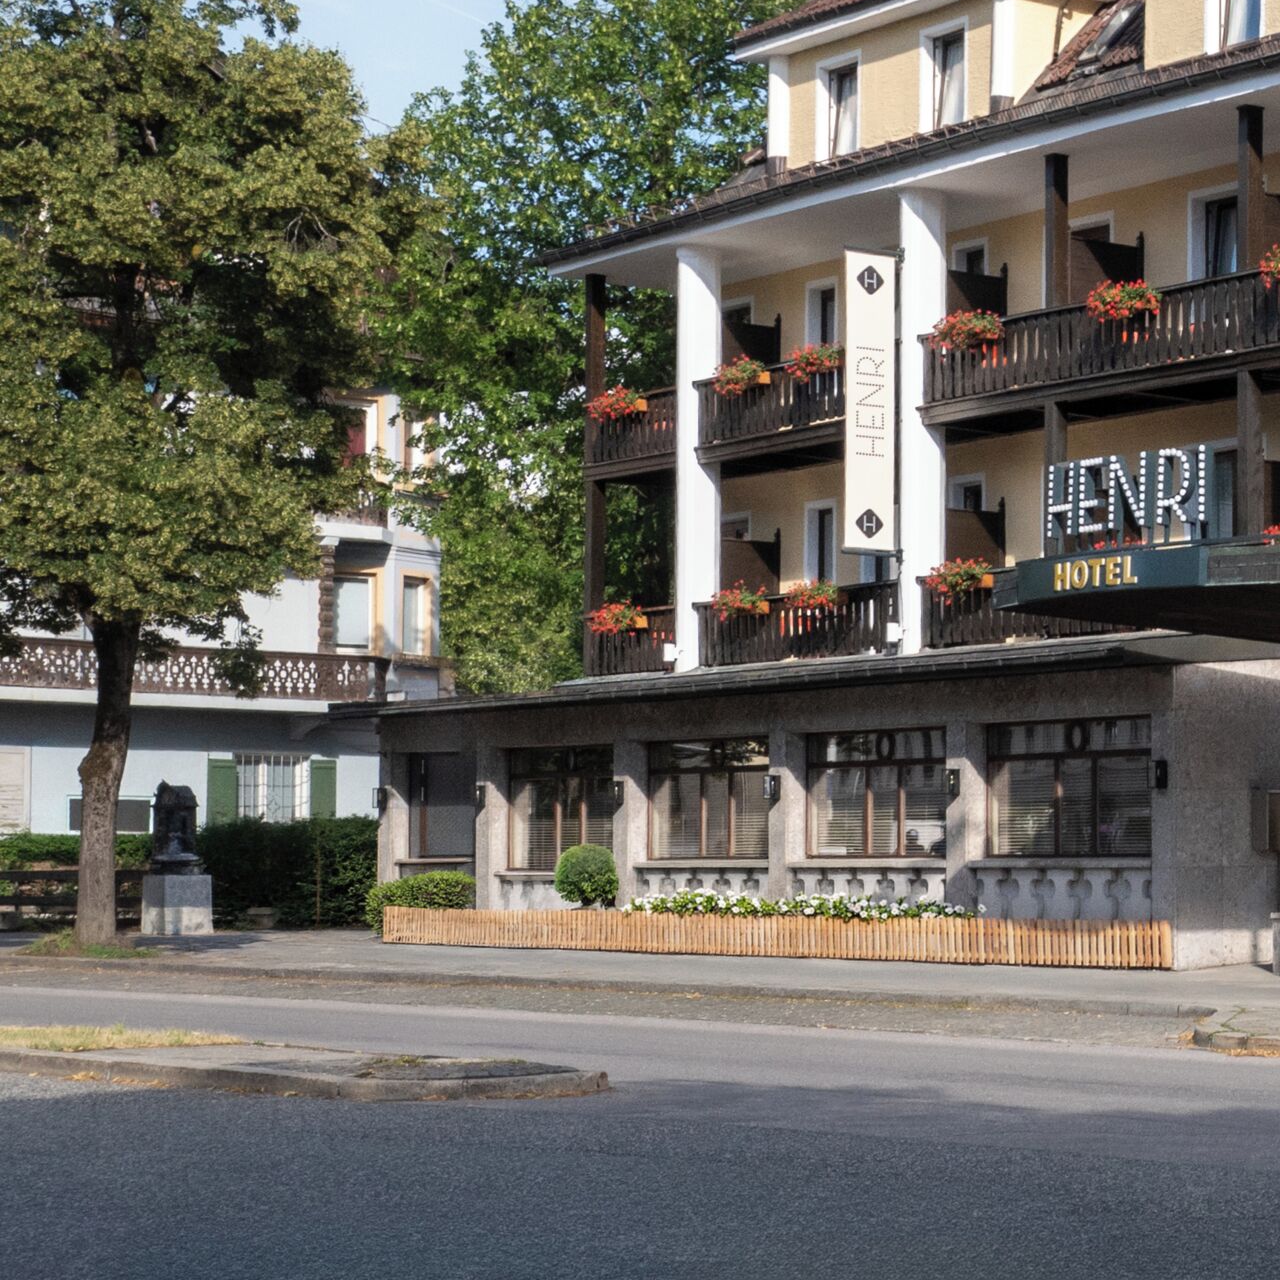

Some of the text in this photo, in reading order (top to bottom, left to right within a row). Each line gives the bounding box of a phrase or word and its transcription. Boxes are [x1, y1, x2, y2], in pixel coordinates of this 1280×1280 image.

[855, 345, 885, 458] HENRI
[1046, 443, 1213, 539] HENRI
[1053, 555, 1139, 592] HOTEL
